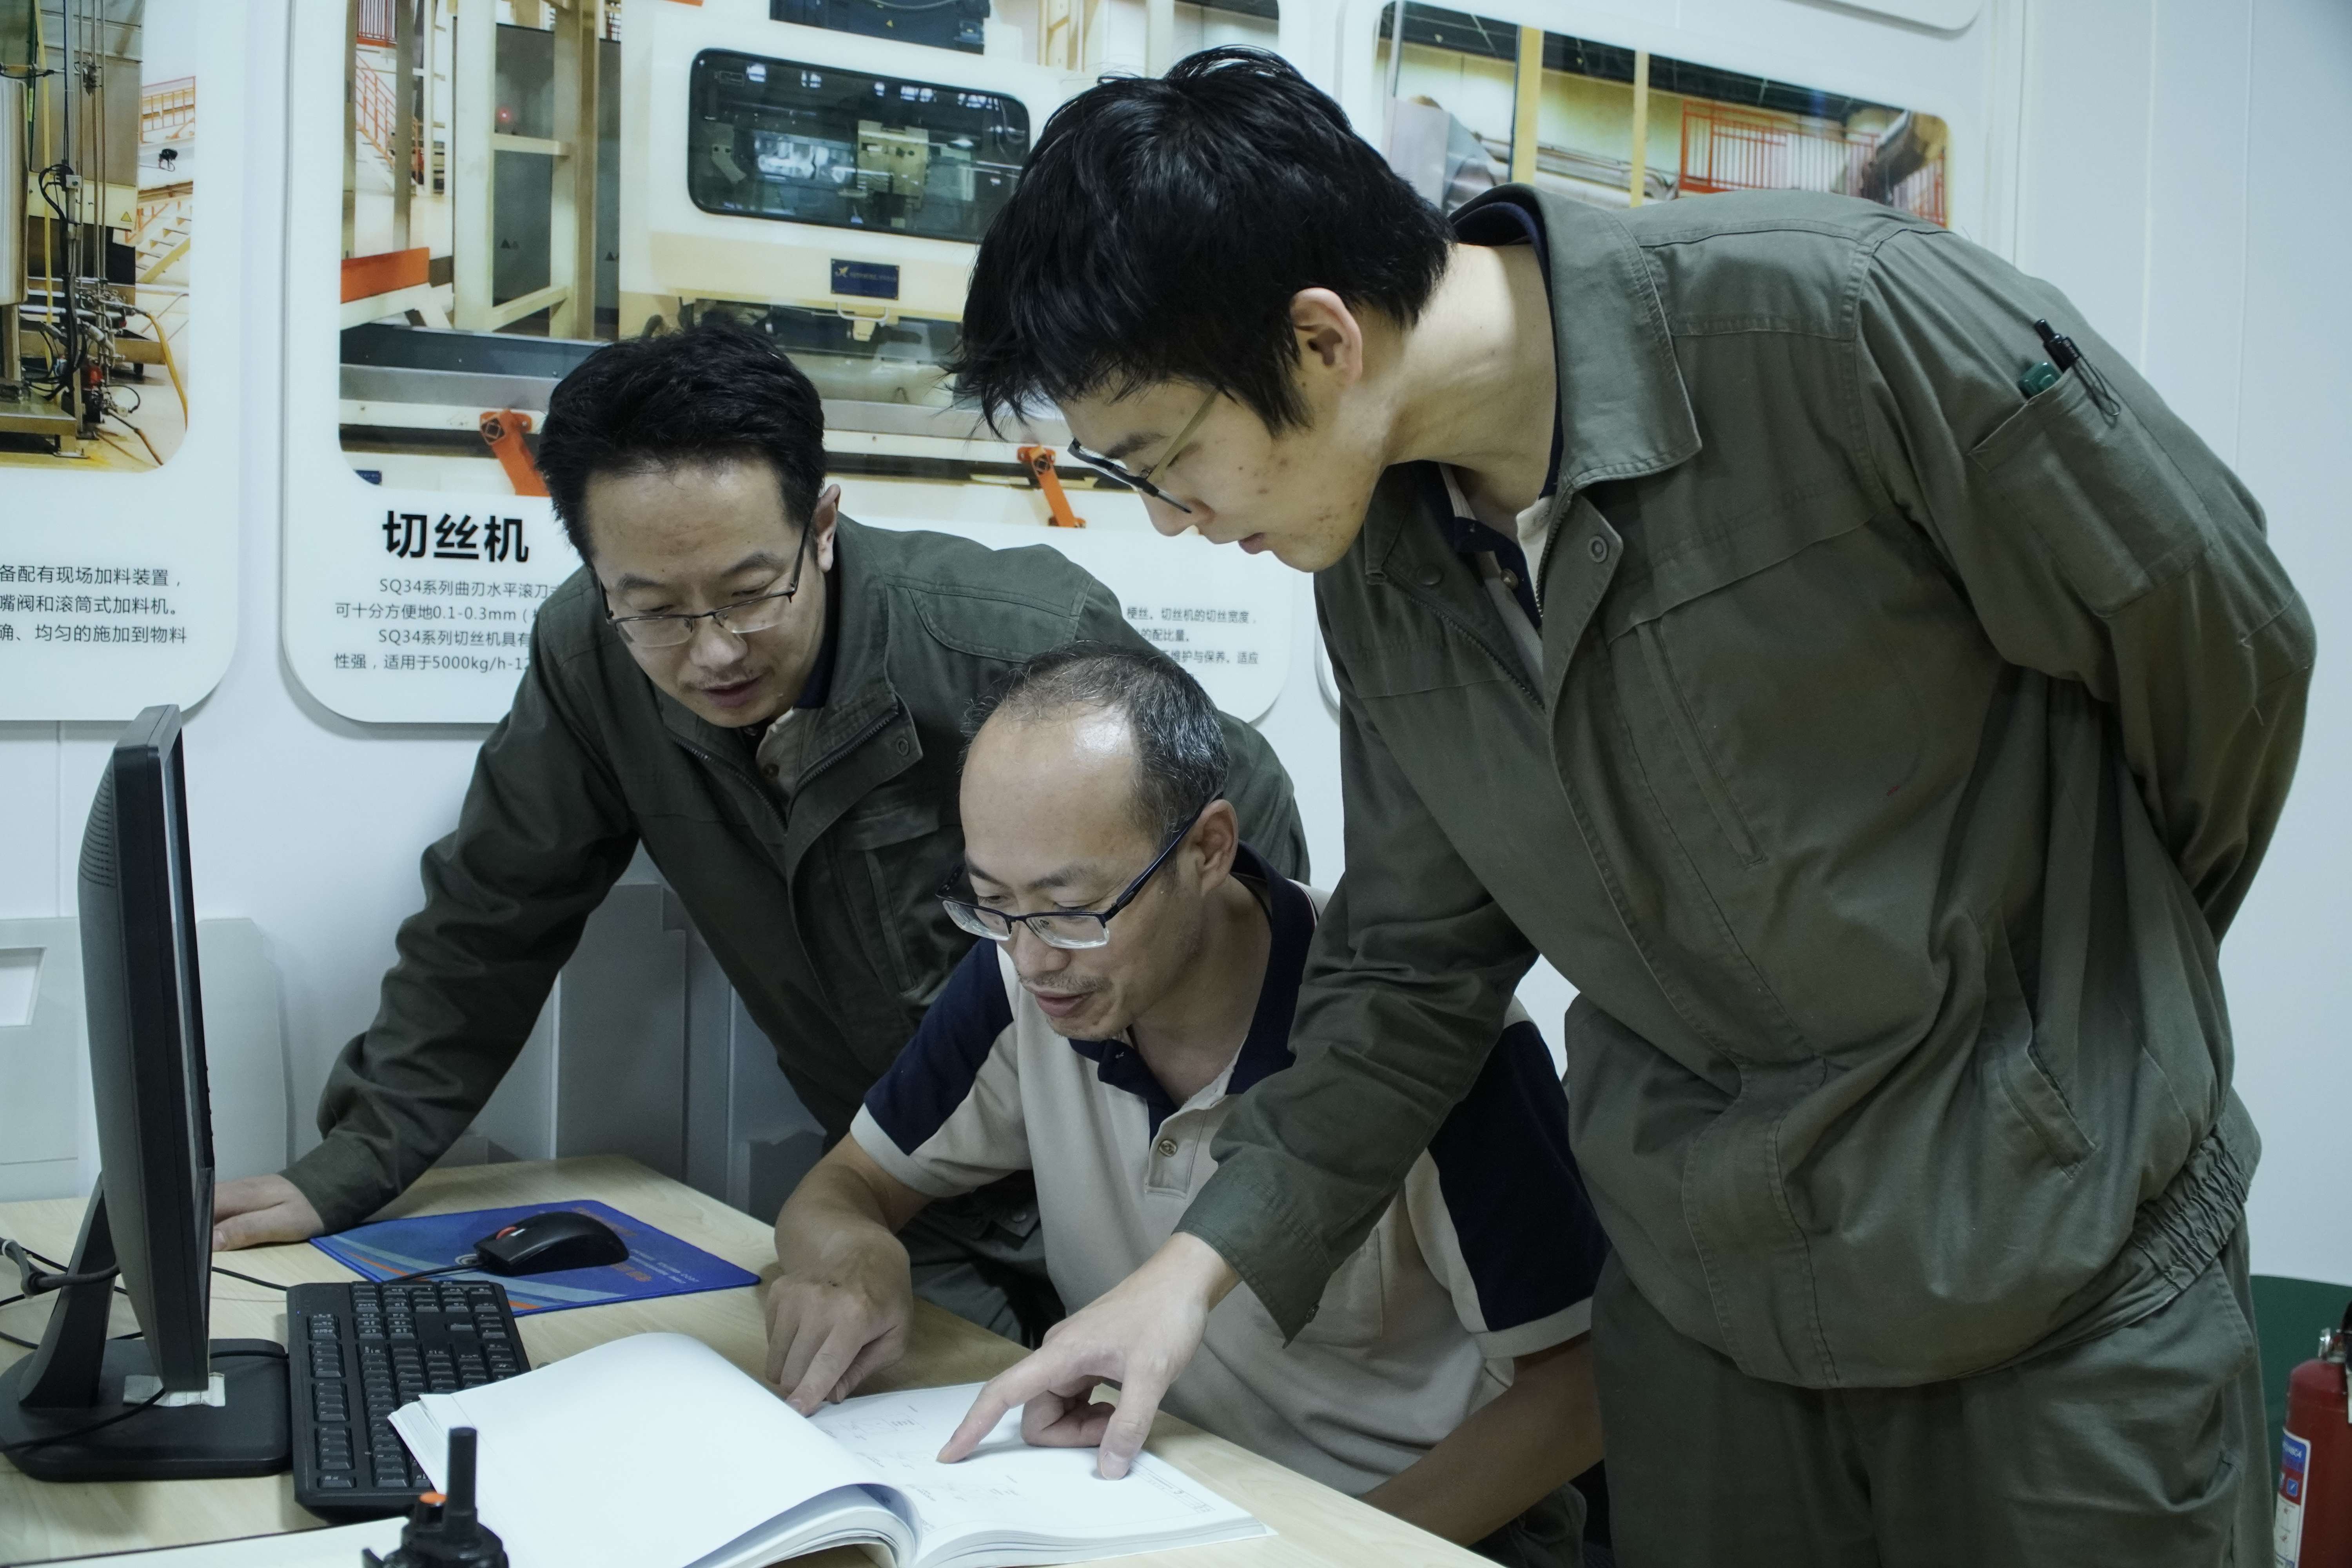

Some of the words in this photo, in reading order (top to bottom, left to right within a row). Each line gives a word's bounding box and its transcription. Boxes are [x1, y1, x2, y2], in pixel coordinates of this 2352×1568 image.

[382, 510, 529, 563] 切丝机
[0, 564, 180, 586] 备配有现场加料装置，
[0, 594, 175, 615] 嘴阀和滚筒式加料机。
[1137, 628, 1190, 642] 的配比量。
